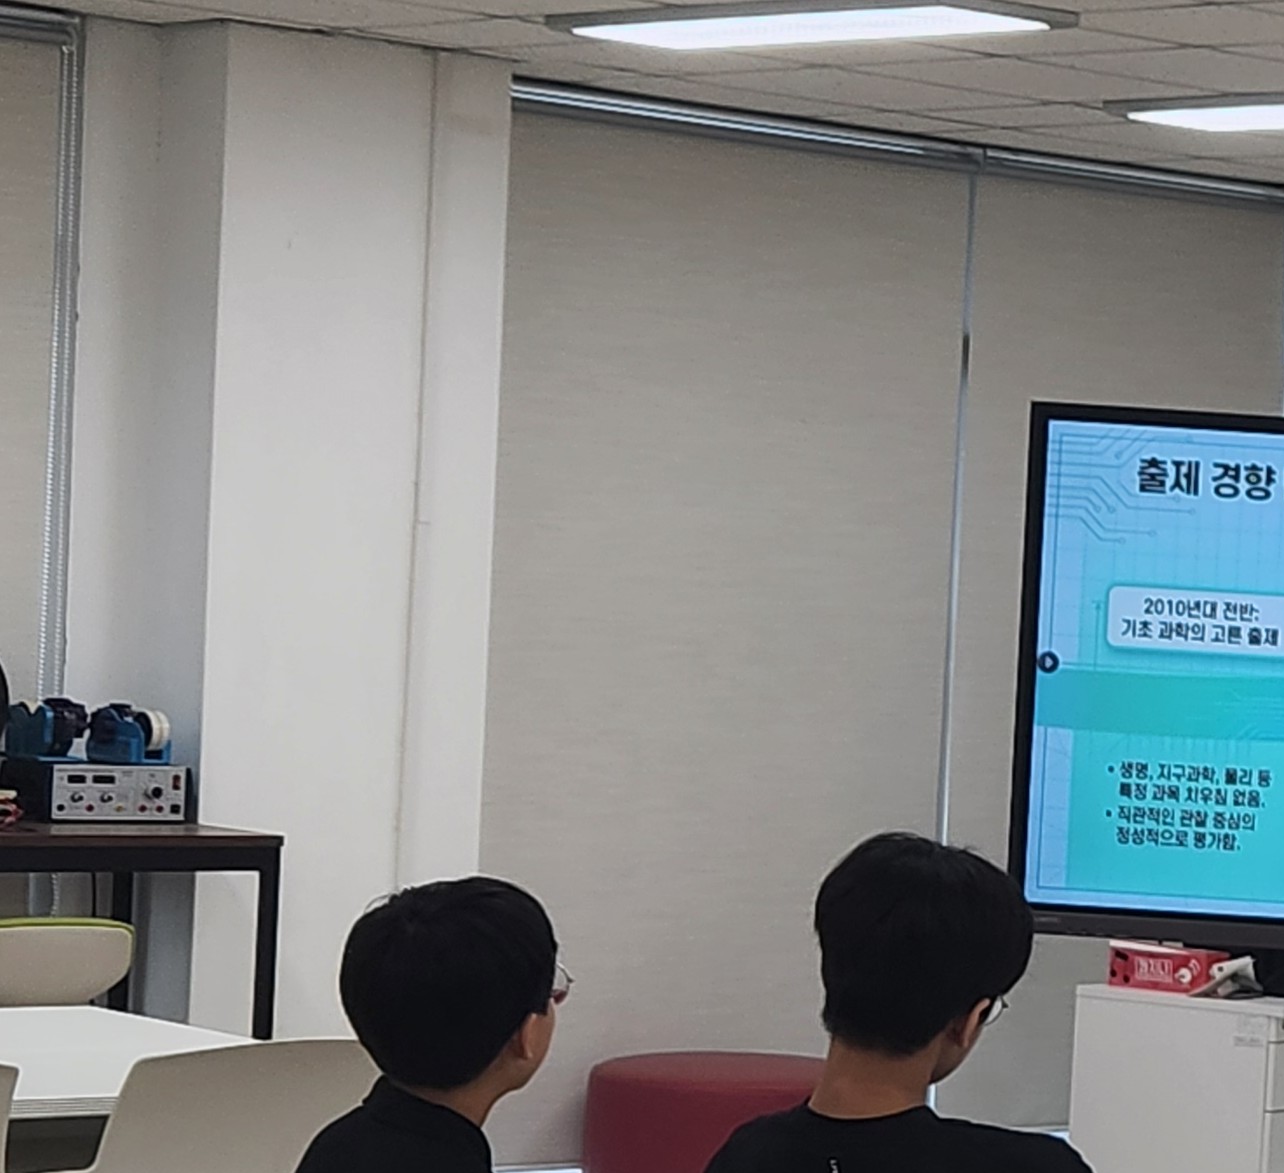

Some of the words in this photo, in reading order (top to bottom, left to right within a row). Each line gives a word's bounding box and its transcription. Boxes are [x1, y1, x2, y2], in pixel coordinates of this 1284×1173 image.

[1137, 457, 1200, 496] 출제
[1212, 462, 1276, 500] 경향
[1144, 598, 1217, 619] 2010년대
[1223, 602, 1259, 622] 전반:
[1121, 619, 1152, 638] 기초
[1159, 621, 1205, 641] 과학의
[1211, 625, 1242, 644] 고른
[1248, 627, 1278, 646] 출제
[1120, 761, 1153, 781] 생명,
[1158, 763, 1219, 785] 지구과학,
[1225, 768, 1252, 786] 물리
[1258, 770, 1271, 787] 등
[1120, 783, 1147, 800] 특정
[1152, 784, 1179, 802] 과목
[1185, 786, 1227, 805] 치우침
[1233, 789, 1265, 808] 없음.
[1118, 806, 1175, 827] 직관적인
[1180, 809, 1208, 827] 관찰
[1213, 812, 1255, 831] 중심의
[1117, 826, 1188, 847] 정성적으로
[1194, 831, 1240, 851] 평가함.
